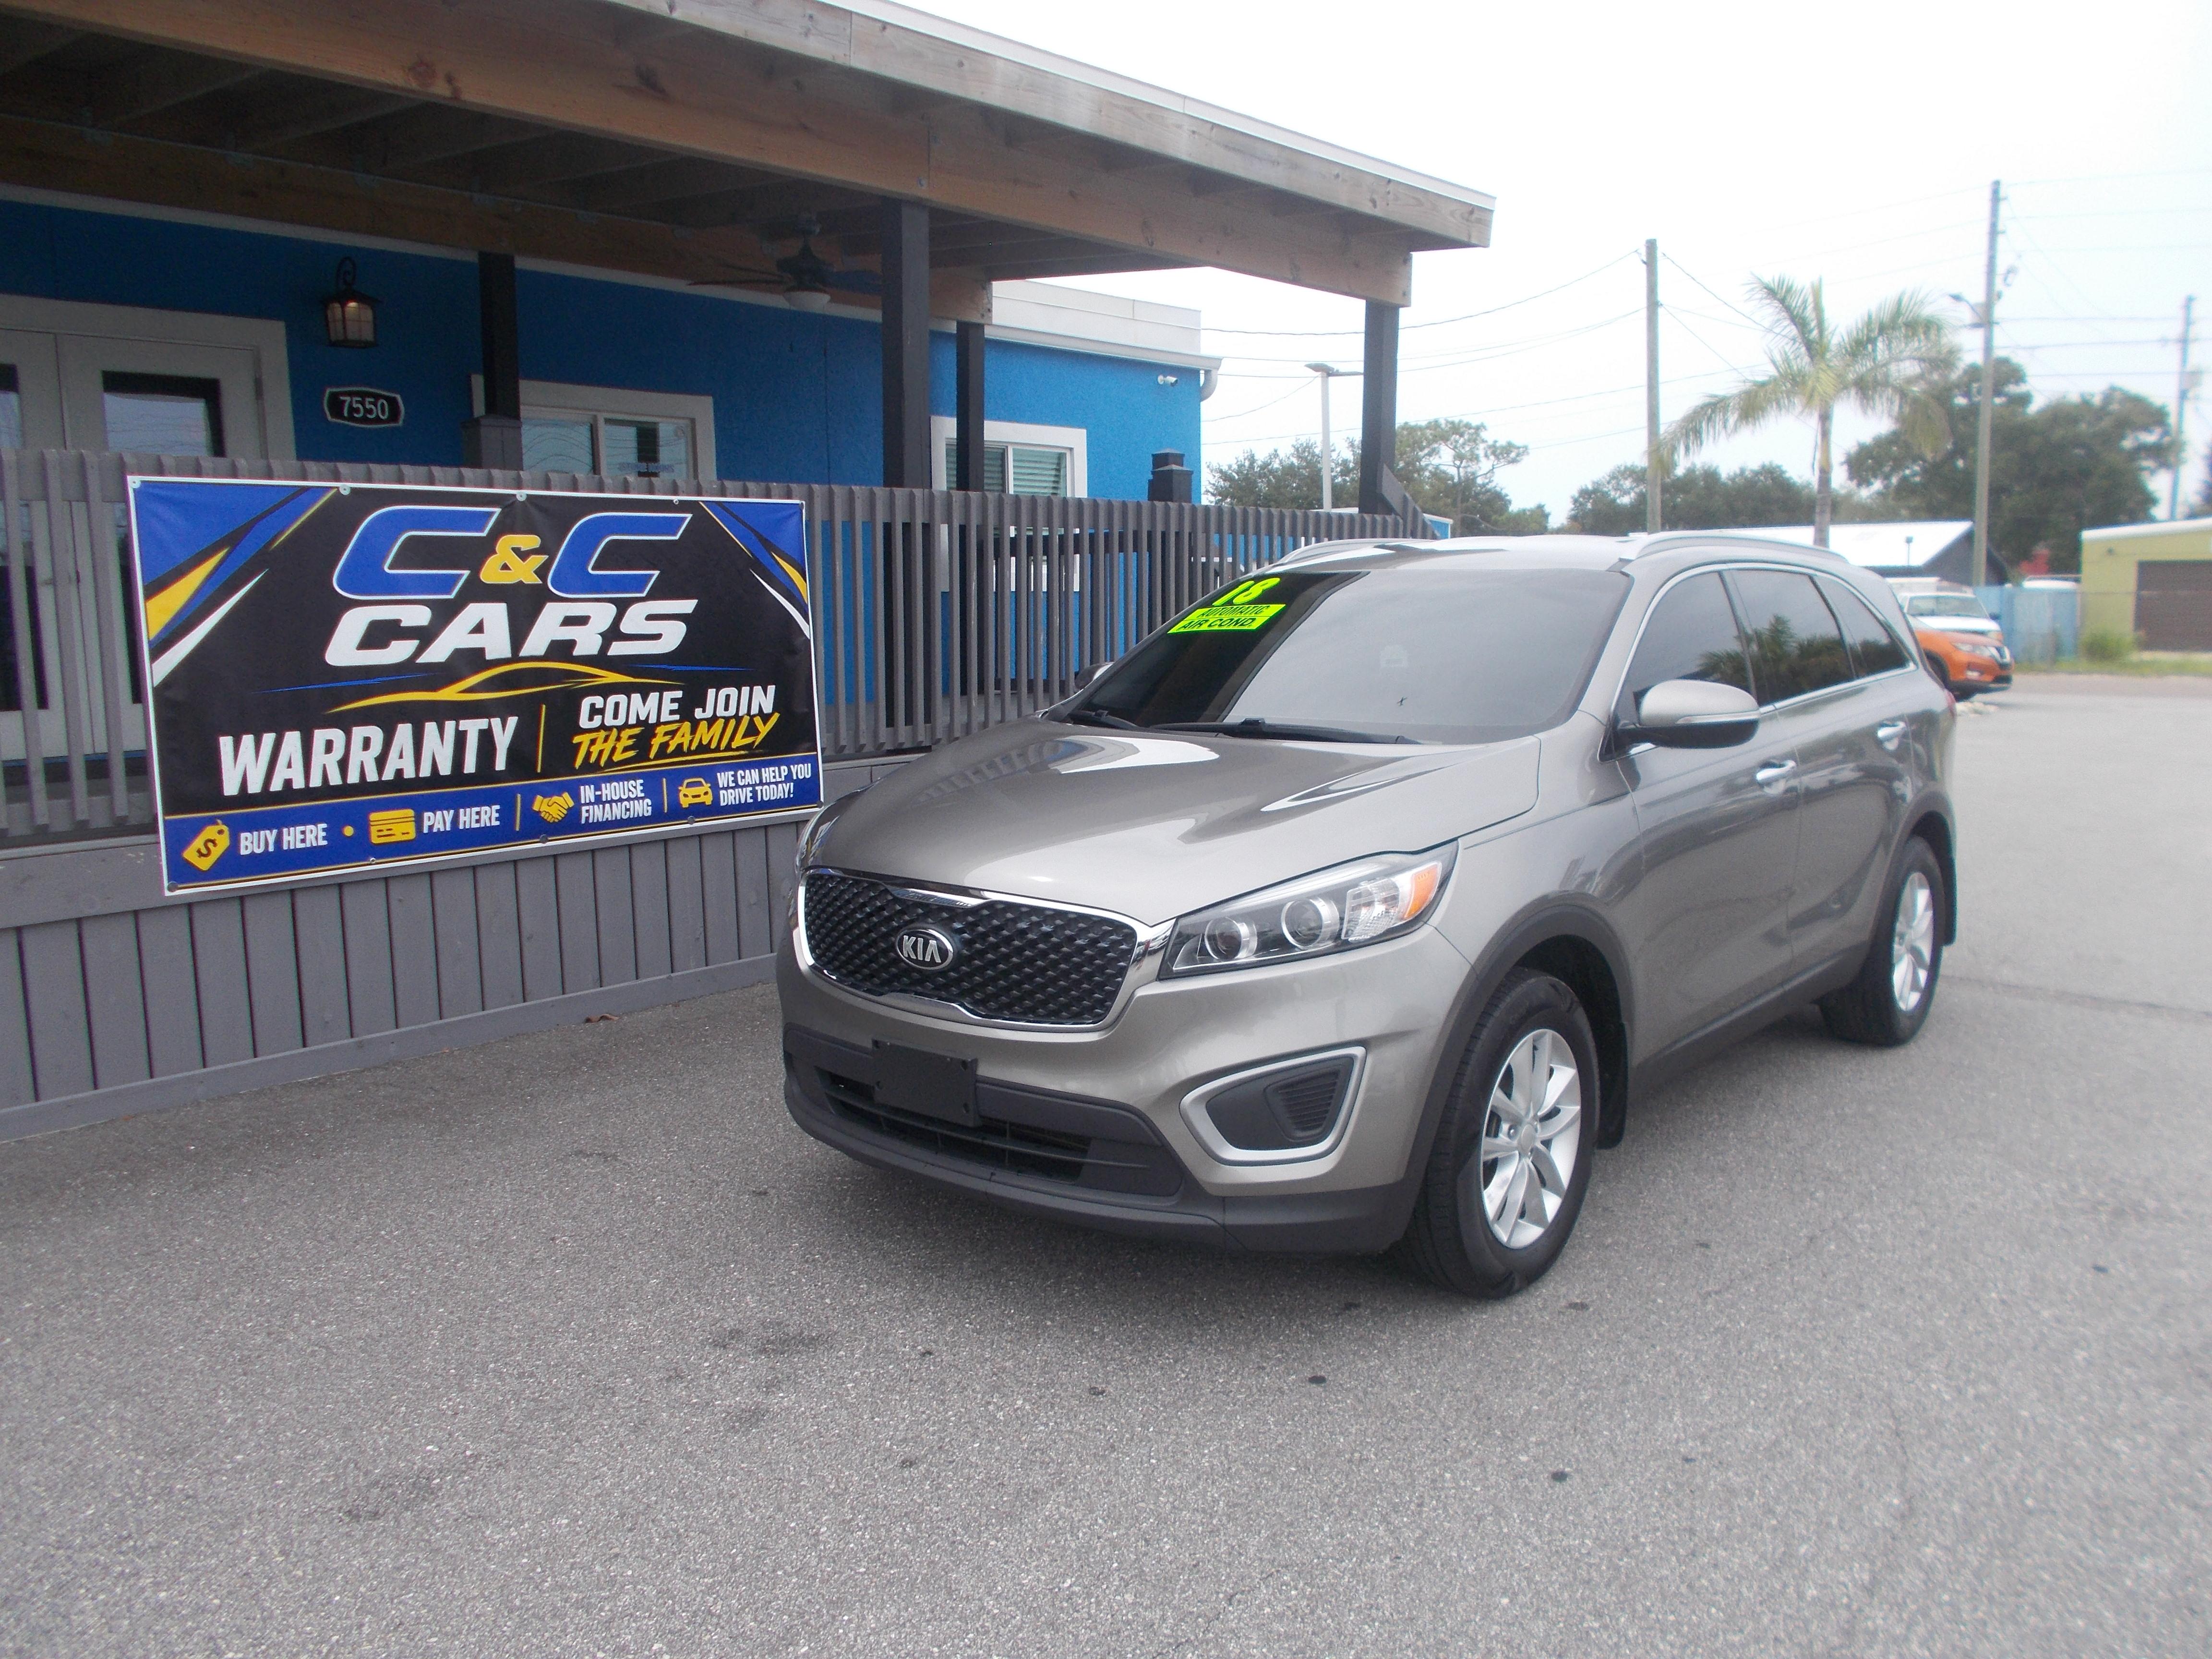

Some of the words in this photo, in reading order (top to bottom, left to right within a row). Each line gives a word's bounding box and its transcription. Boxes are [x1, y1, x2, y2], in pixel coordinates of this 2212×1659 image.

[339, 397, 388, 419] 7550
[333, 505, 693, 600] C&C
[1212, 577, 1280, 606] 18
[1177, 619, 1210, 630] AIR
[1197, 605, 1270, 618] AUTOMATIC
[325, 600, 698, 666] CARS
[579, 691, 683, 729] COME
[694, 685, 776, 719] JOIN
[573, 727, 644, 769] THE
[649, 712, 781, 759] FAMILY
[219, 717, 518, 796] WARRANTY
[718, 771, 736, 788] WE
[738, 769, 760, 786] CAN
[762, 766, 789, 784] HELP
[790, 763, 812, 780] YOU
[580, 779, 644, 804] IN-HOUSE
[720, 786, 753, 806] DRIVE
[757, 783, 794, 801] TODAY!
[422, 809, 454, 833] PAY
[459, 805, 501, 830] HERE
[581, 798, 652, 824] FINANCING
[240, 828, 278, 855] BUY
[283, 823, 328, 850] HERE
[902, 935, 941, 963] KIA
